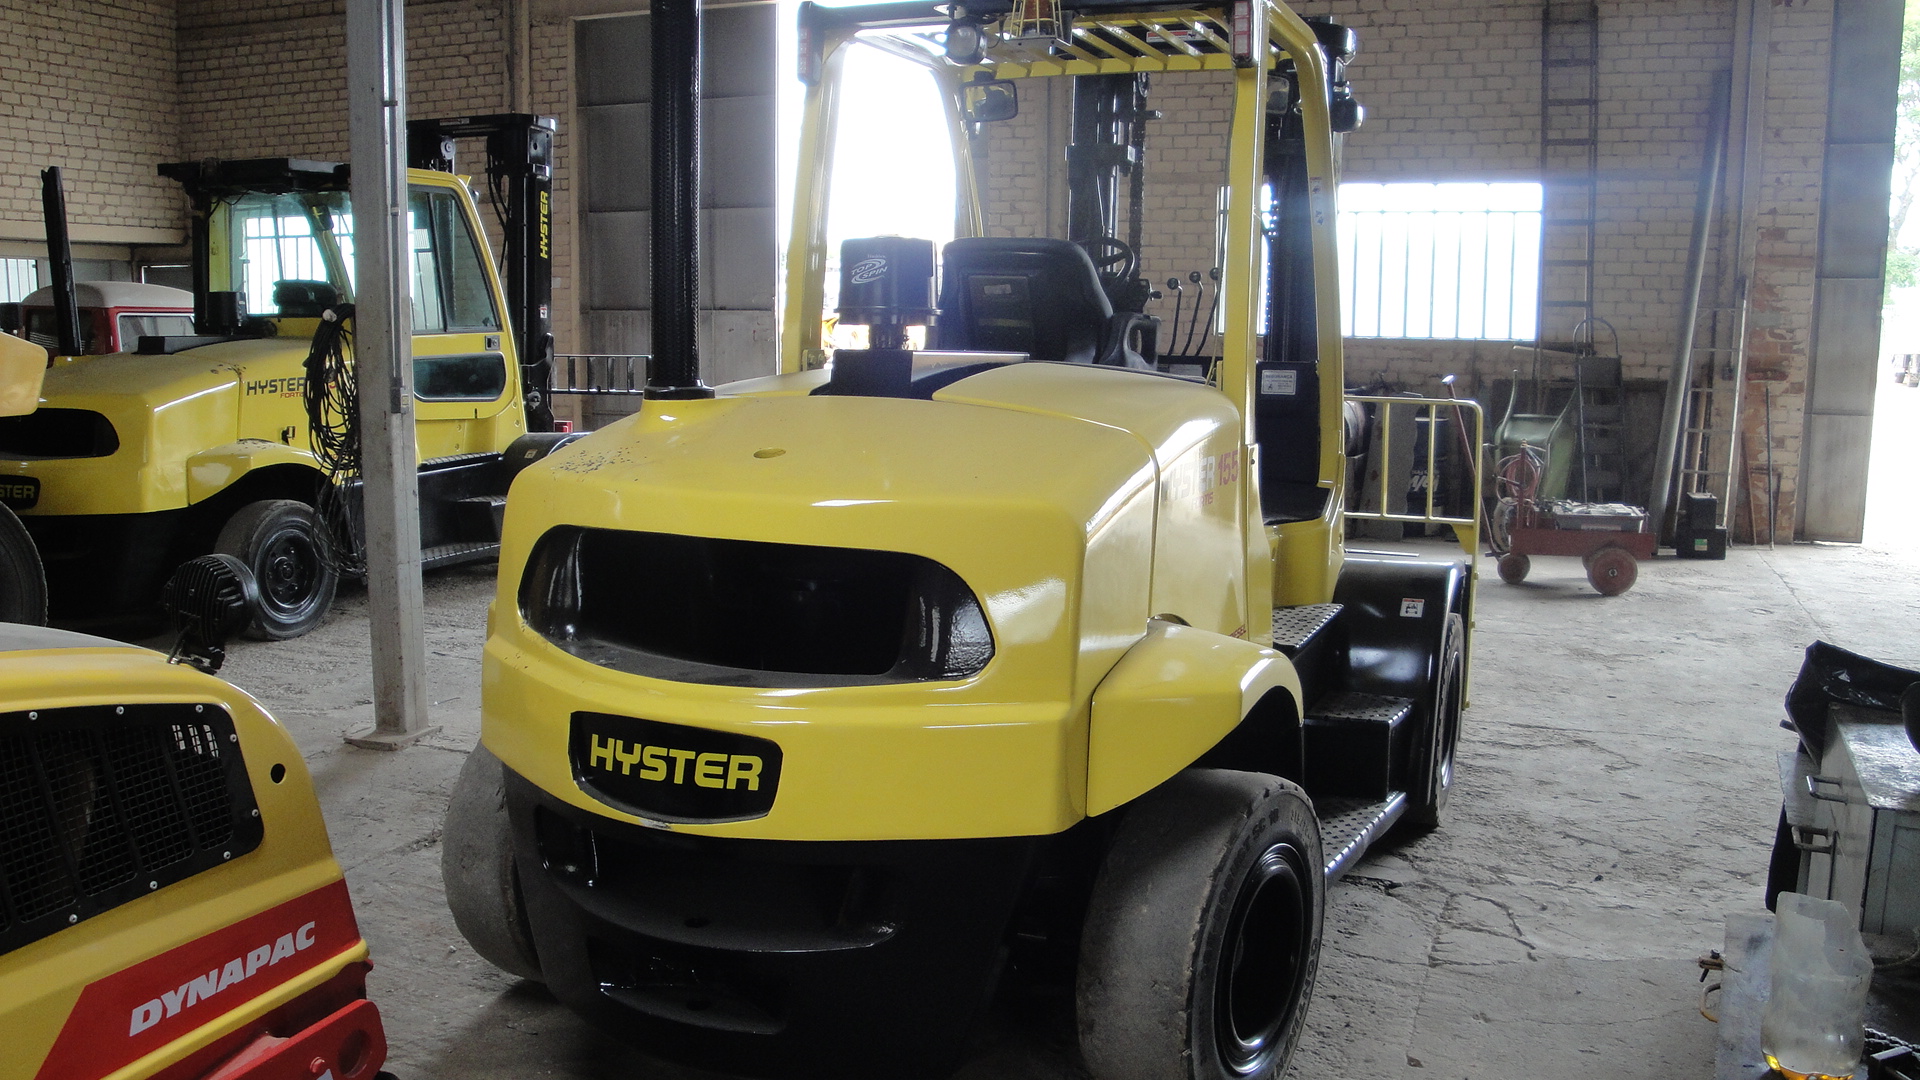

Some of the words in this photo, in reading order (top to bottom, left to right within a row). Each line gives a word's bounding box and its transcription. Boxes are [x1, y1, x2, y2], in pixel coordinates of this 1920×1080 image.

[539, 190, 549, 259] HYSTER
[851, 263, 873, 275] TOP
[862, 266, 888, 279] SPIN
[1217, 449, 1239, 487] 155
[590, 733, 763, 791] HYSTER
[129, 921, 315, 1037] DYNAPAC
